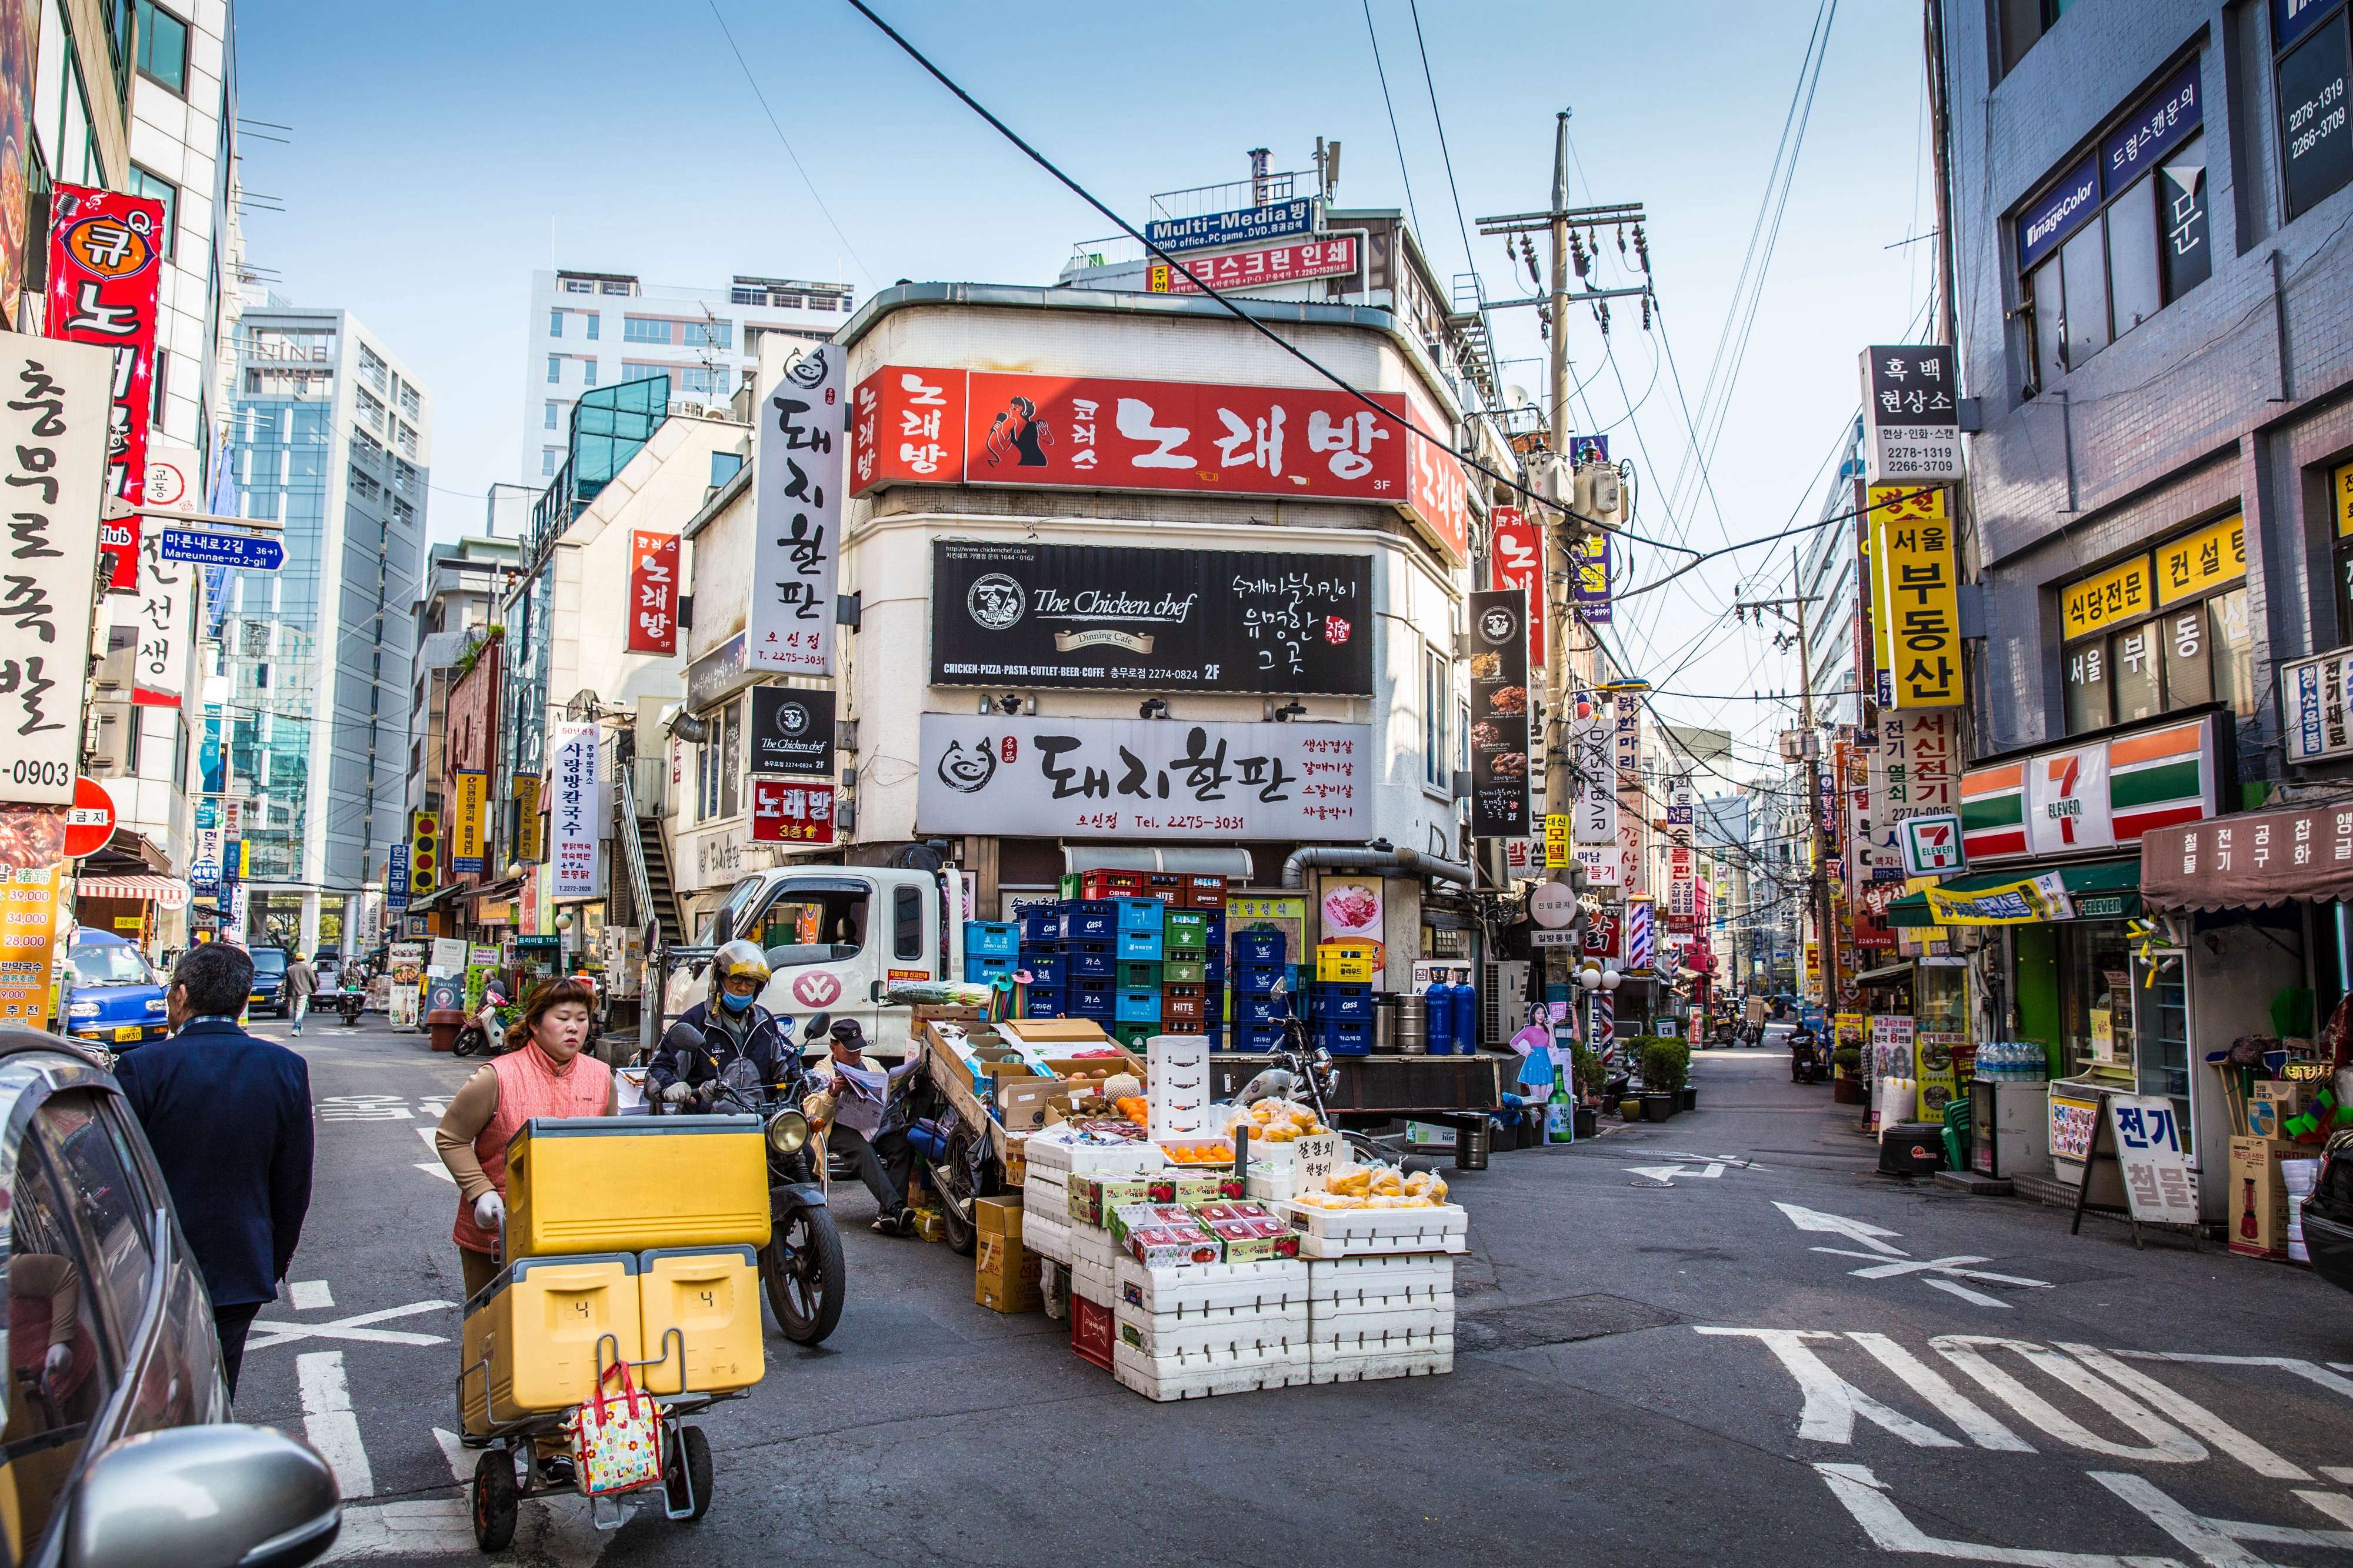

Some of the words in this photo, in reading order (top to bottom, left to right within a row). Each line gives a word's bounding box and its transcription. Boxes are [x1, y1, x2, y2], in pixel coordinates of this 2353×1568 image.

[2289, 78, 2343, 133] 2278-1319
[2292, 106, 2345, 160] 2266-3709
[125, 209, 151, 236] Q
[1153, 208, 1286, 240] Multi-Media
[1290, 202, 1305, 219] 방
[2027, 180, 2093, 248] ImageColor
[83, 223, 131, 267] 큐
[1154, 237, 1176, 251] SOHO
[1301, 240, 1348, 266] 인쇄
[258, 345, 328, 362] NINE
[1884, 357, 1941, 382] 흑백
[1879, 389, 1953, 414] 현상소
[857, 386, 878, 482] 노래방
[899, 372, 947, 474] 노래방
[1072, 396, 1099, 471] 코러스
[1115, 396, 1390, 478] 노래방
[1887, 447, 1952, 459] 2278-1319
[1888, 461, 1953, 472] 2266-3709
[151, 469, 168, 498] 교동
[1374, 479, 1391, 491] 3F
[1418, 434, 1465, 541] 노래방
[773, 397, 832, 620] 돼지한판
[256, 546, 268, 555] 36
[636, 536, 677, 552] 코러스
[946, 545, 1028, 554] http://www.chickenchef.co.kr
[1893, 526, 1946, 553] 서울
[165, 548, 240, 565] Mareunnae-ro
[243, 556, 266, 568] 2-gil
[639, 555, 672, 640] 노래방
[1232, 572, 1355, 605] 수제마늘치킨이
[2070, 571, 2142, 626] 식당전문
[1034, 589, 1069, 613] The
[1074, 590, 1151, 615] Chicken
[1154, 593, 1198, 624] chef
[1243, 602, 1319, 641] 유명한
[1898, 562, 1954, 699] 부동산
[1078, 631, 1109, 646] Dinning
[1111, 633, 1133, 646] Cafe
[2071, 649, 2101, 686] 서울
[2123, 595, 2249, 673] 부동산
[772, 652, 825, 665] 2275-3031
[1259, 650, 1275, 669] 그
[1286, 641, 1304, 675] 곳
[1110, 667, 1146, 679] 충무로점
[1149, 669, 1198, 680] 2274-0824
[1204, 664, 1220, 680] 2F
[2300, 666, 2322, 753] 청소용품
[2324, 659, 2347, 747] 전기재료
[1618, 696, 1638, 769] 닭한마리
[1884, 719, 1905, 759] 전기
[762, 738, 776, 749] The
[777, 739, 808, 750] Chicken
[809, 741, 827, 754] chef
[1002, 736, 1018, 763] 名品
[1302, 738, 1355, 755] 생삼겹살
[816, 760, 824, 769] 2F
[1033, 726, 1298, 805] 돼지한판
[1302, 760, 1355, 776] 갈매기살
[1912, 715, 1949, 804] 서신전기
[561, 742, 584, 837] 사랑방칼국수
[1302, 783, 1354, 799] 소갈비살
[1887, 763, 1907, 805] 열쇠
[756, 788, 834, 821] 노래방
[1302, 805, 1353, 820] 차돌박이
[1508, 812, 1517, 821] 2F
[779, 825, 802, 839] 3층
[1075, 812, 1118, 830] 오신정
[1135, 816, 1160, 829] Tel.
[1167, 815, 1244, 830] 2275-3031
[1548, 817, 1566, 826] 대신
[1548, 828, 1565, 860] 모텔
[2254, 824, 2269, 869] 공구
[2294, 819, 2312, 865] 잡화
[2335, 812, 2353, 860] 앵글
[1508, 841, 1527, 867] 발
[1578, 851, 1601, 863] 미남
[2183, 832, 2197, 874] 철물
[2217, 829, 2232, 870] 전기
[17, 869, 51, 882] 猪蹄
[391, 846, 406, 894] 한국코팅
[561, 870, 589, 879] 토종닭
[10, 890, 49, 900] 39,000
[1538, 901, 1571, 910] 진입금지
[7, 913, 47, 924] 34,000
[1227, 901, 1287, 916] 쌈밥정식
[1086, 920, 1102, 929] Cass
[5, 936, 45, 946] 28,000
[1538, 933, 1572, 943] 일방통행
[1085, 958, 1101, 966] 카스
[1340, 968, 1362, 976] 클라우드
[1084, 995, 1100, 1003] 카스
[1173, 1002, 1194, 1012] HITE
[1342, 1001, 1358, 1010] Cass
[121, 1032, 140, 1041] 8930
[1874, 1036, 1888, 1044] 전국
[1889, 1033, 1912, 1045] 8만원
[2116, 1107, 2179, 1152] 전기
[1305, 1162, 1331, 1176] 한봉지
[2127, 1162, 2191, 1210] 철물
[576, 1301, 588, 1318] 4
[701, 1291, 712, 1307] 4
